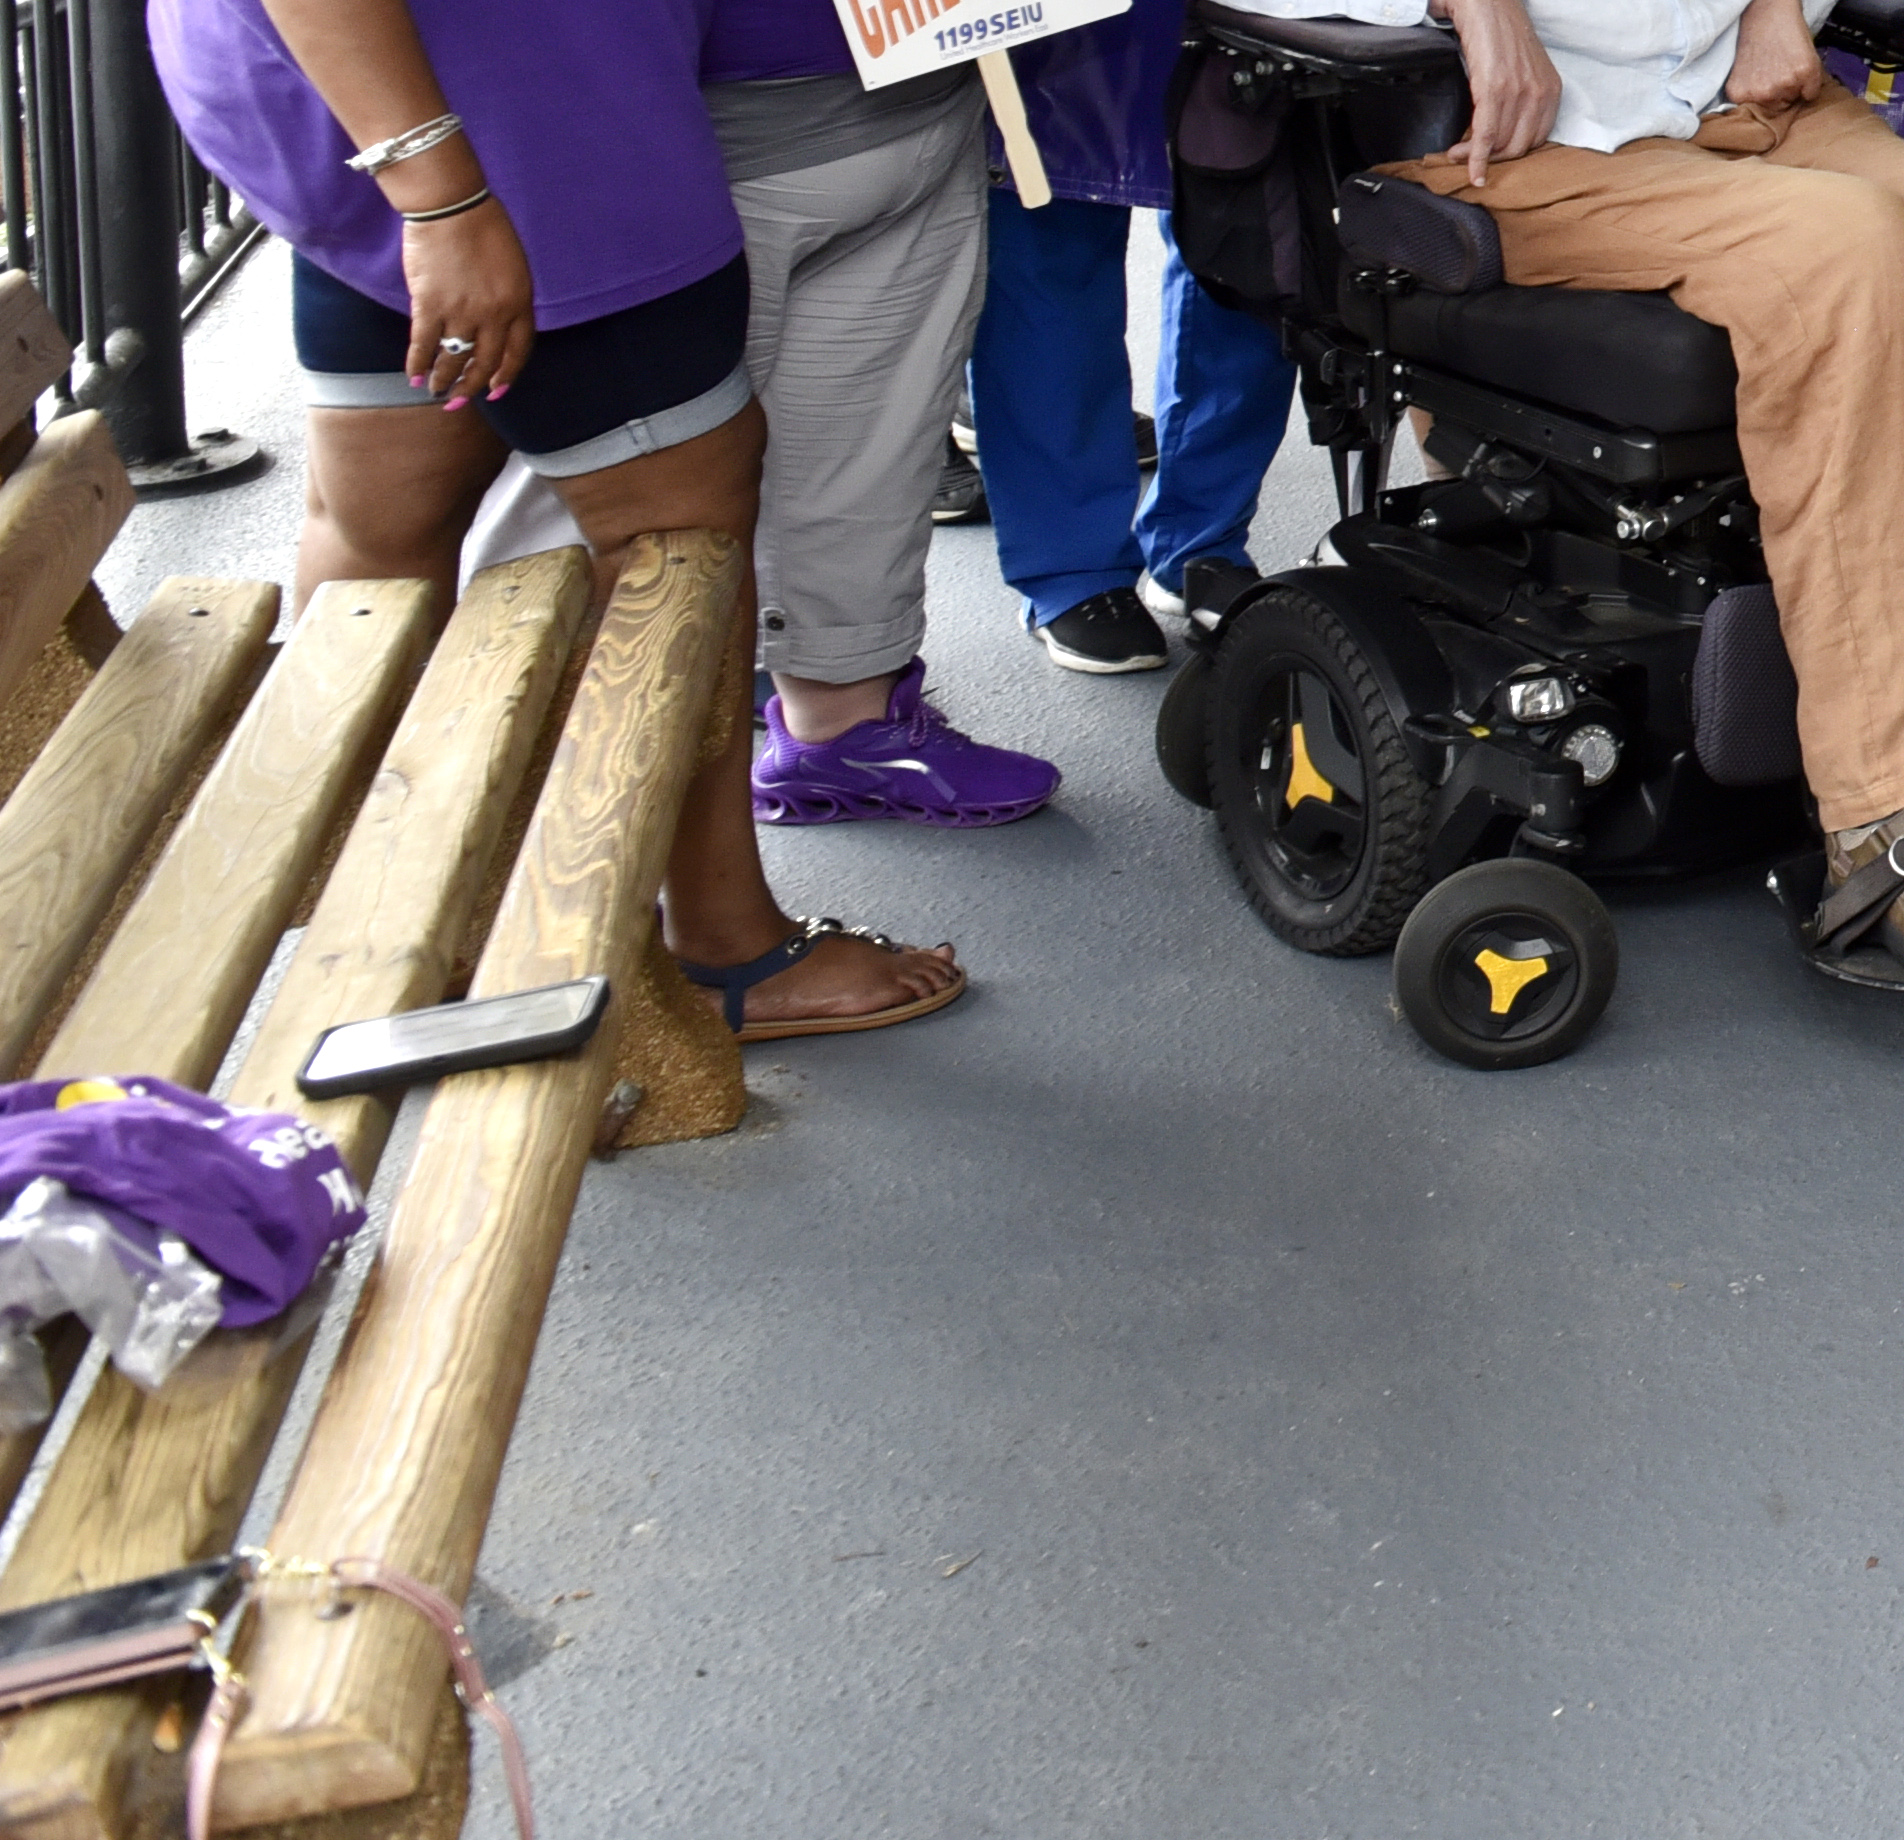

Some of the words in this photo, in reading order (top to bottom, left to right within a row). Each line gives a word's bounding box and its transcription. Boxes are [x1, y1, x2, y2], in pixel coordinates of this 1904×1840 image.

[932, 1, 1044, 52] 1199SEIU
[966, 37, 1003, 54] Healthcare
[1004, 28, 1035, 45] Workers
